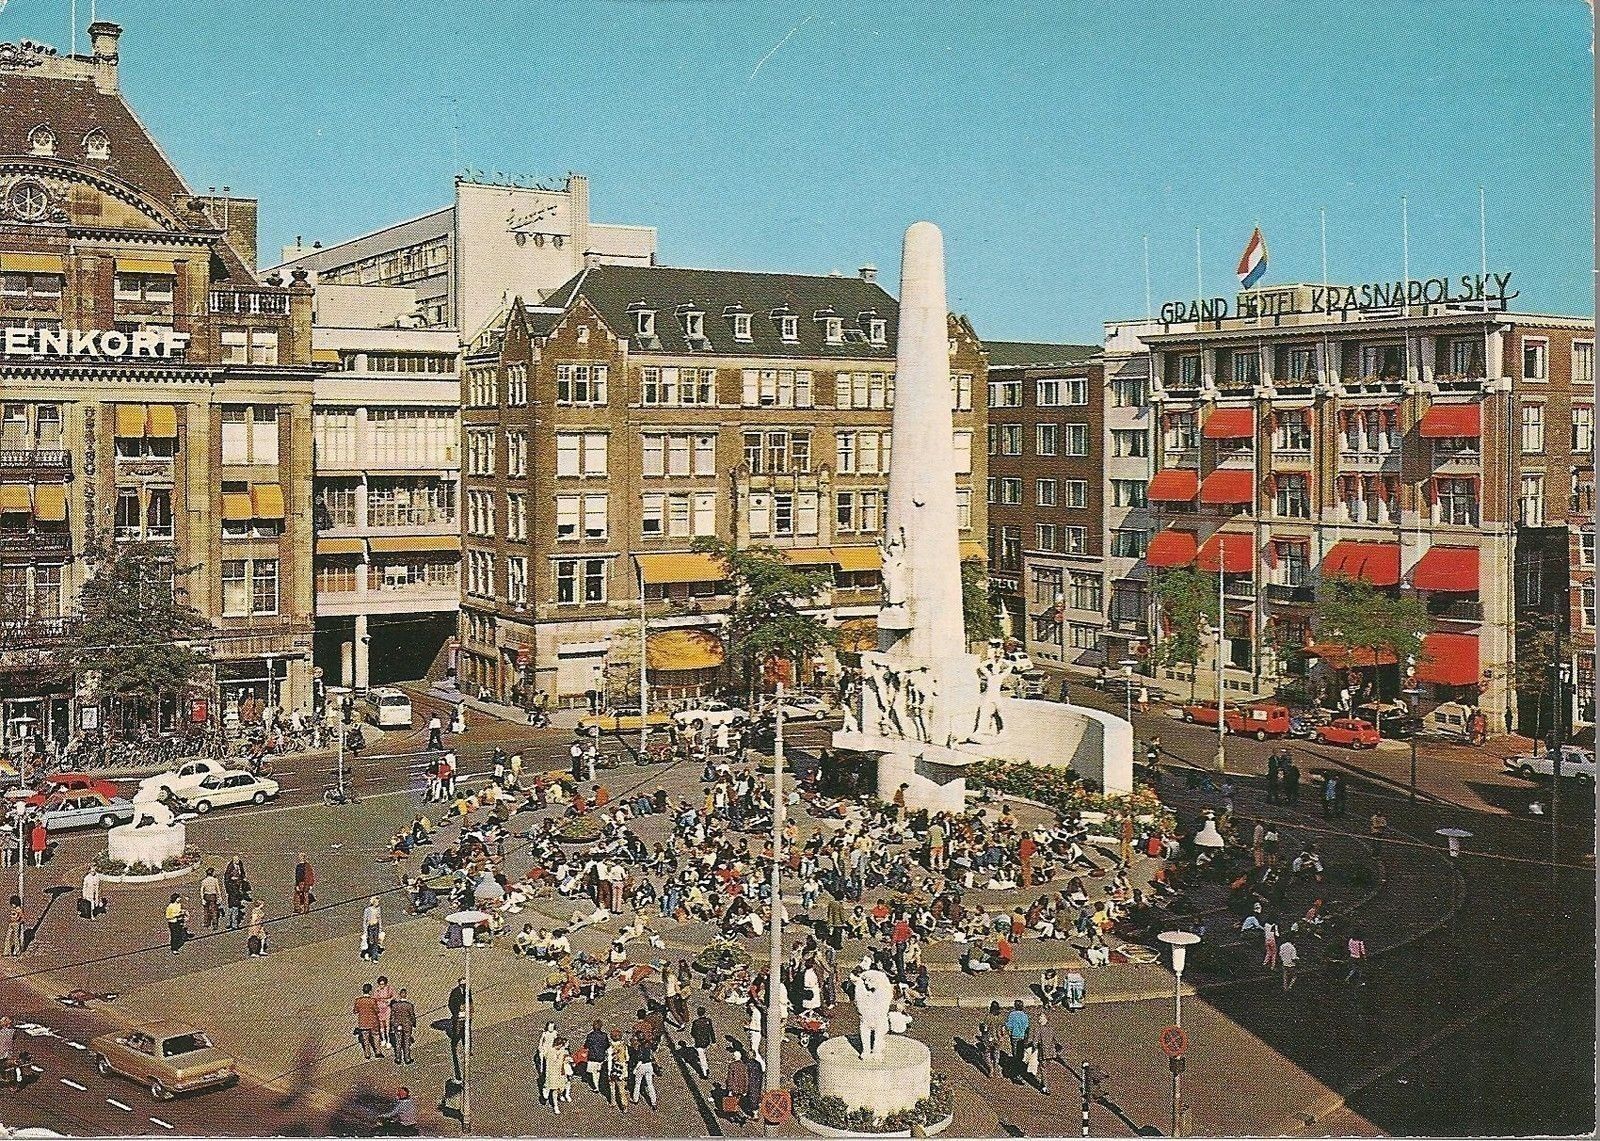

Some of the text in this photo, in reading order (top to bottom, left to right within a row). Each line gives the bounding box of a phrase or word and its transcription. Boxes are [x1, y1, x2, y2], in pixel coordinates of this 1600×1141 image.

[1160, 271, 1520, 325] GRAND HOTEL KRASNAPOLSKY
[5, 327, 191, 358] ENKORF
